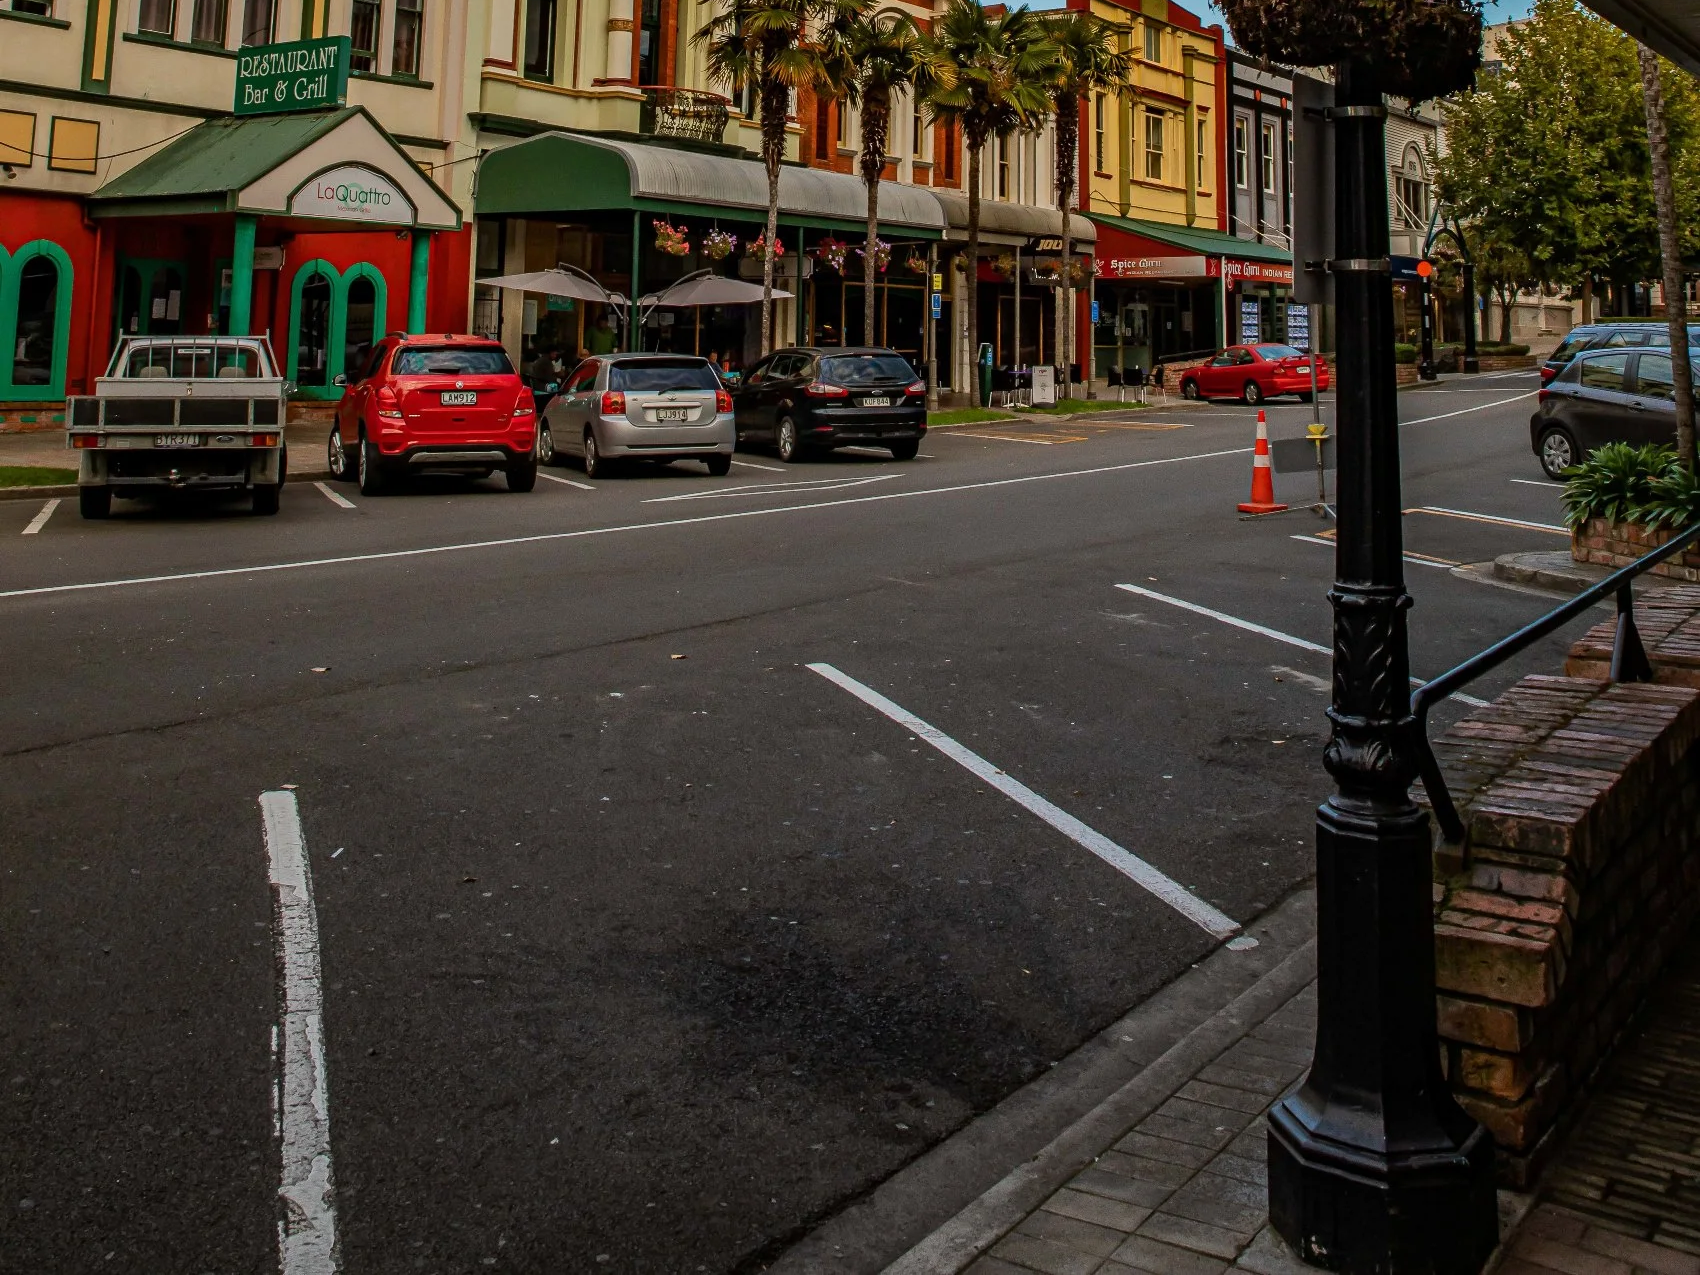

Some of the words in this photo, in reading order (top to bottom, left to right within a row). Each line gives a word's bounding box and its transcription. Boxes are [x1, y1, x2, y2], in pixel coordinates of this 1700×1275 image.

[240, 46, 338, 78] RESTAURANT
[244, 84, 269, 105] Bar
[274, 80, 288, 102] &
[294, 74, 328, 100] Grill
[1110, 259, 1136, 272] Spice
[1224, 261, 1241, 277] Spice
[1243, 261, 1260, 277] Guru
[1262, 268, 1283, 278] INDIAN
[156, 433, 198, 445] BYR371
